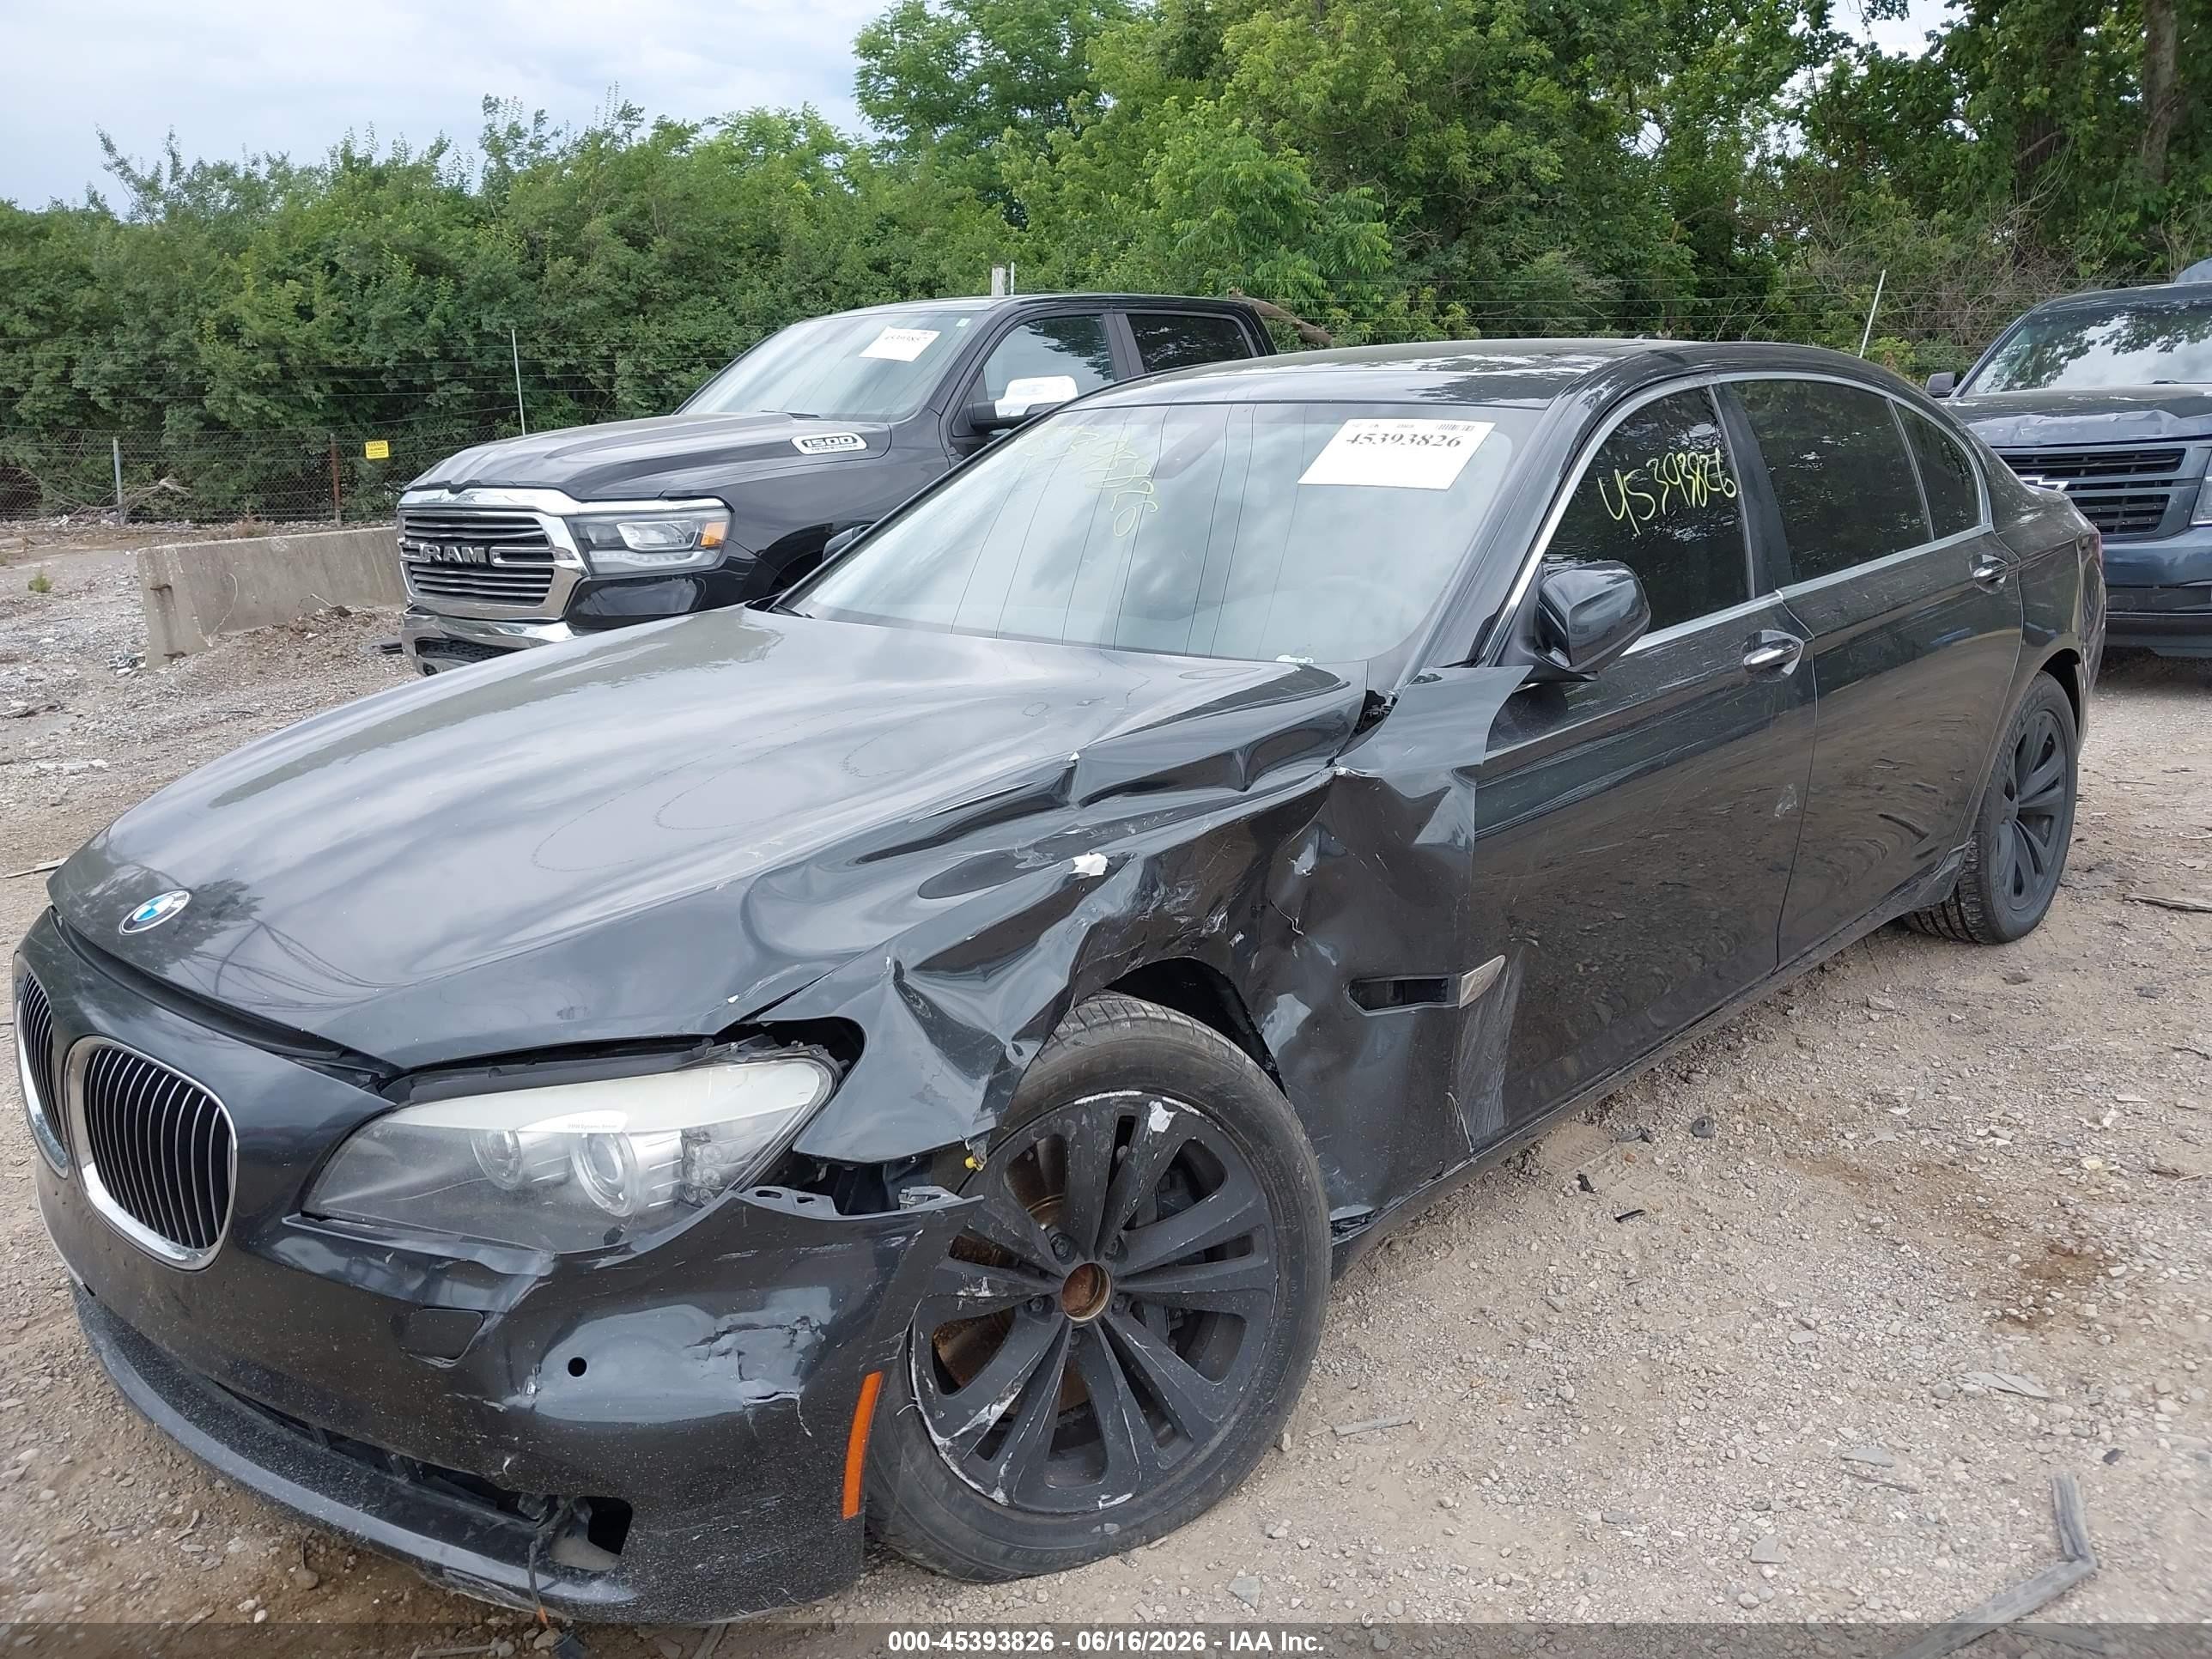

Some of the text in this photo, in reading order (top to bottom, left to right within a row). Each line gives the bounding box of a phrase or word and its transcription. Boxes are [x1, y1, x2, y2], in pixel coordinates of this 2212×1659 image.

[802, 435, 857, 448] 1500
[1346, 432, 1464, 448] 45393826
[422, 544, 487, 563] RAM
